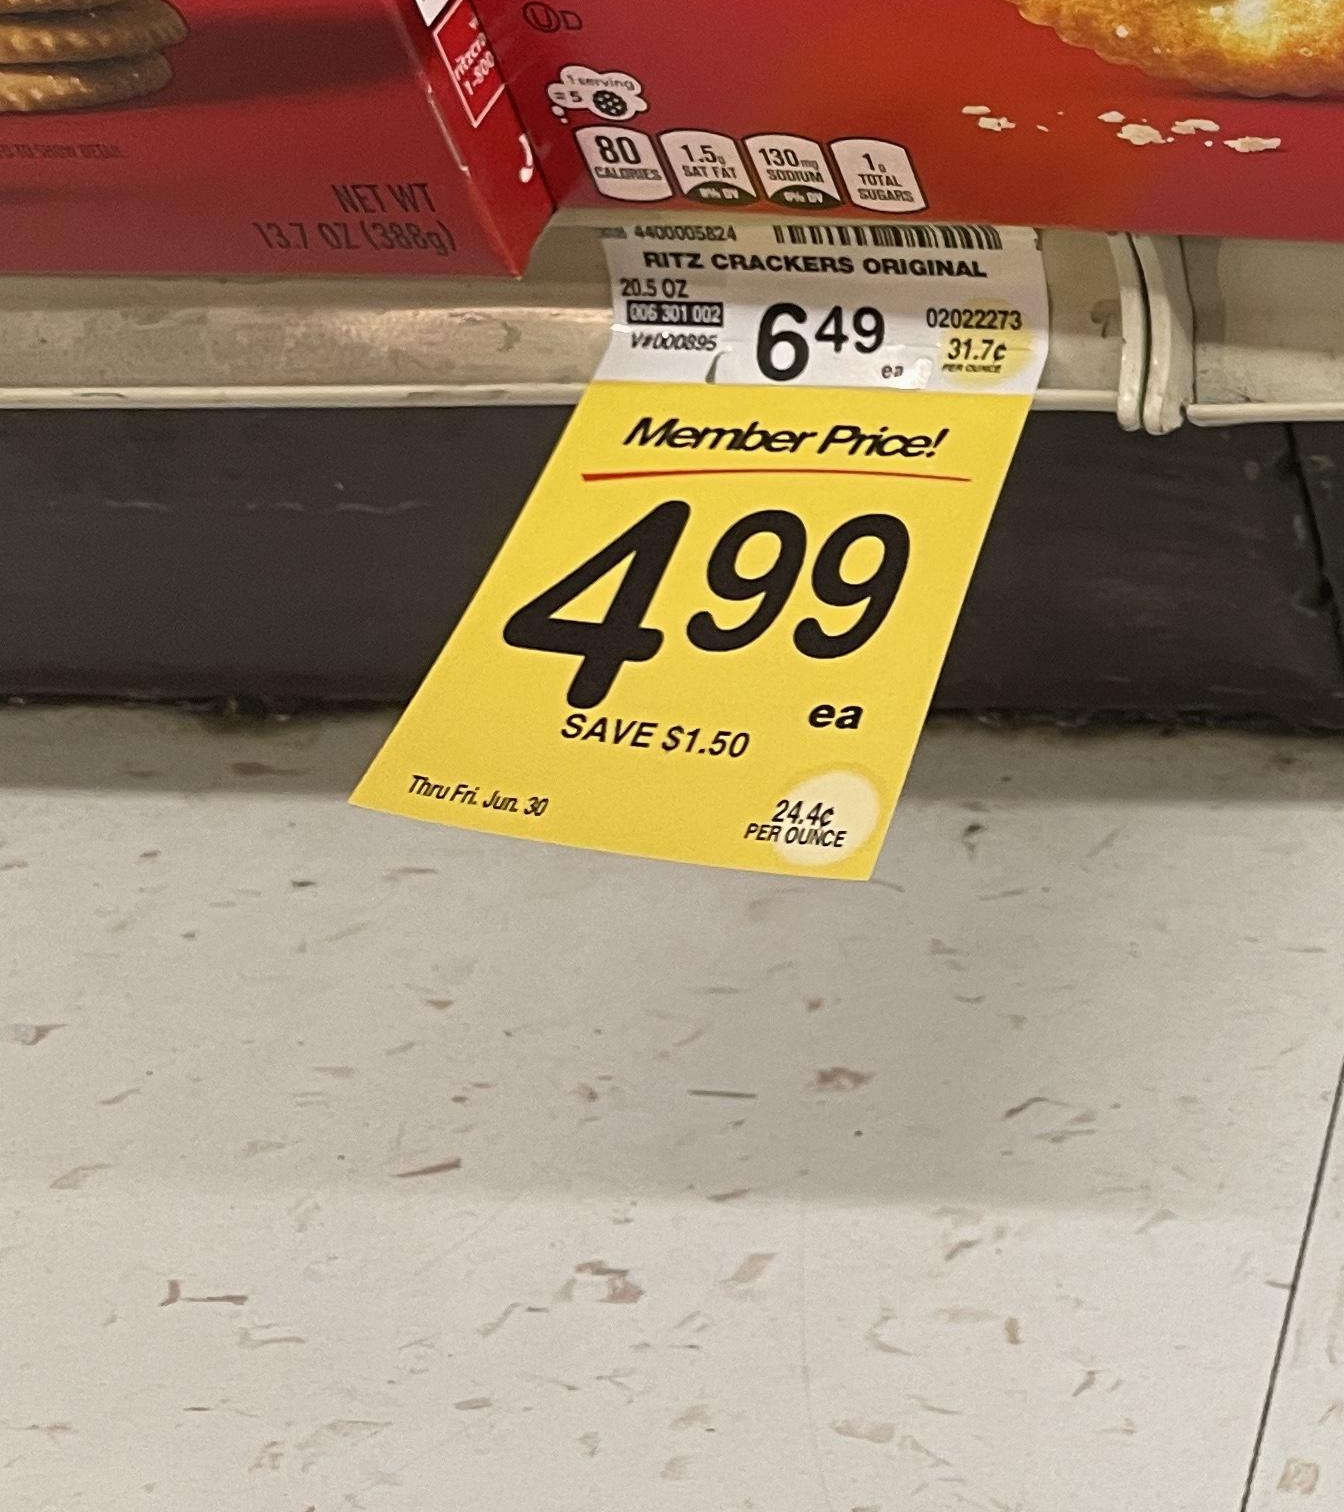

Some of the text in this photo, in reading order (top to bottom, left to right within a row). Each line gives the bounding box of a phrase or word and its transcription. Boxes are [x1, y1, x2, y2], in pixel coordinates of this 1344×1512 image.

[595, 134, 642, 166] 80
[767, 169, 825, 184] SODIUM
[857, 173, 904, 189] TOTAL
[332, 183, 437, 214] NET WT
[857, 188, 915, 204] SUGARS
[254, 221, 310, 251] 13.7
[318, 221, 360, 250] OZ
[643, 251, 988, 279] RITZ CRACKERS ORIGINAL
[619, 277, 689, 299] 20.5 OZ
[926, 307, 1023, 331] 02022273
[881, 364, 904, 379] ea
[622, 416, 950, 459] Member Price!
[807, 702, 864, 731] ea
[560, 713, 751, 759] SAVE $1.50
[407, 773, 549, 819] Thru Fri. Jun. 30
[744, 821, 848, 849] PER OUNCE
